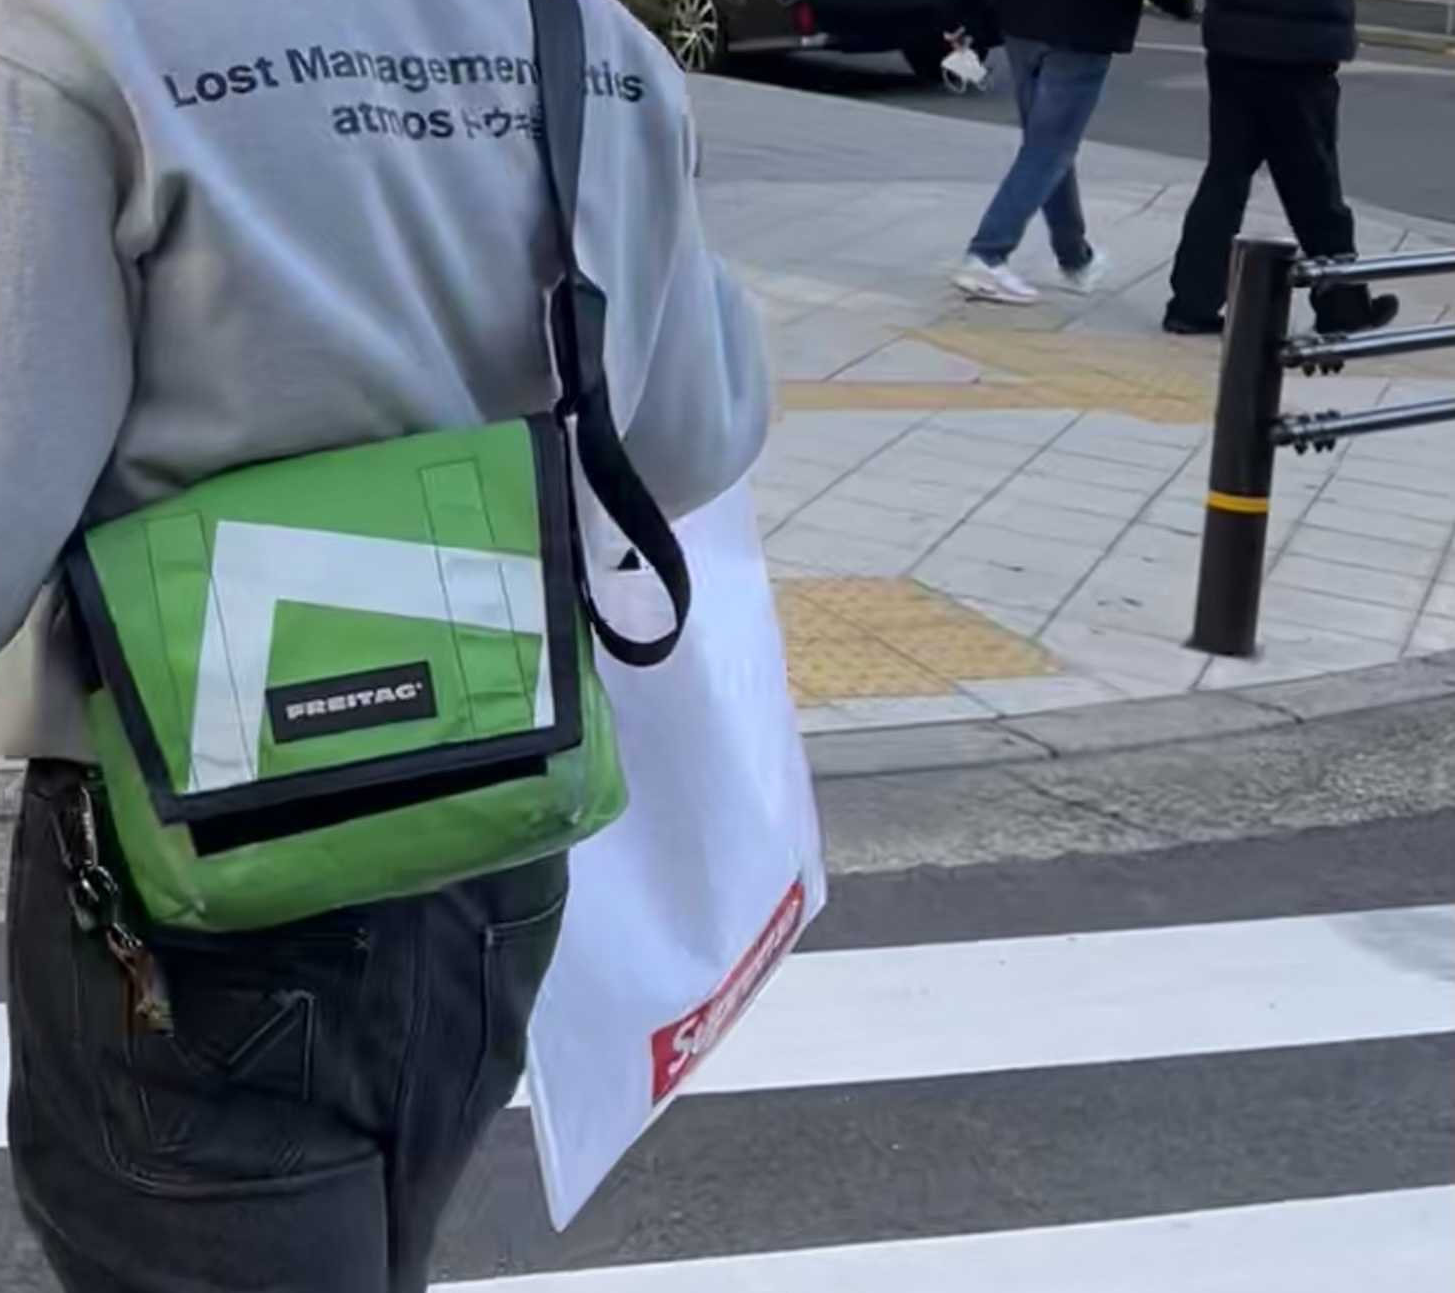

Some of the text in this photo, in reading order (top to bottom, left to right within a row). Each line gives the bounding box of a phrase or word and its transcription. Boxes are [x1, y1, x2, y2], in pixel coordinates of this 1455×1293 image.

[163, 55, 281, 107] Lost
[285, 46, 542, 93] Managemen
[332, 102, 455, 141] atmos
[285, 682, 423, 720] FREITAG
